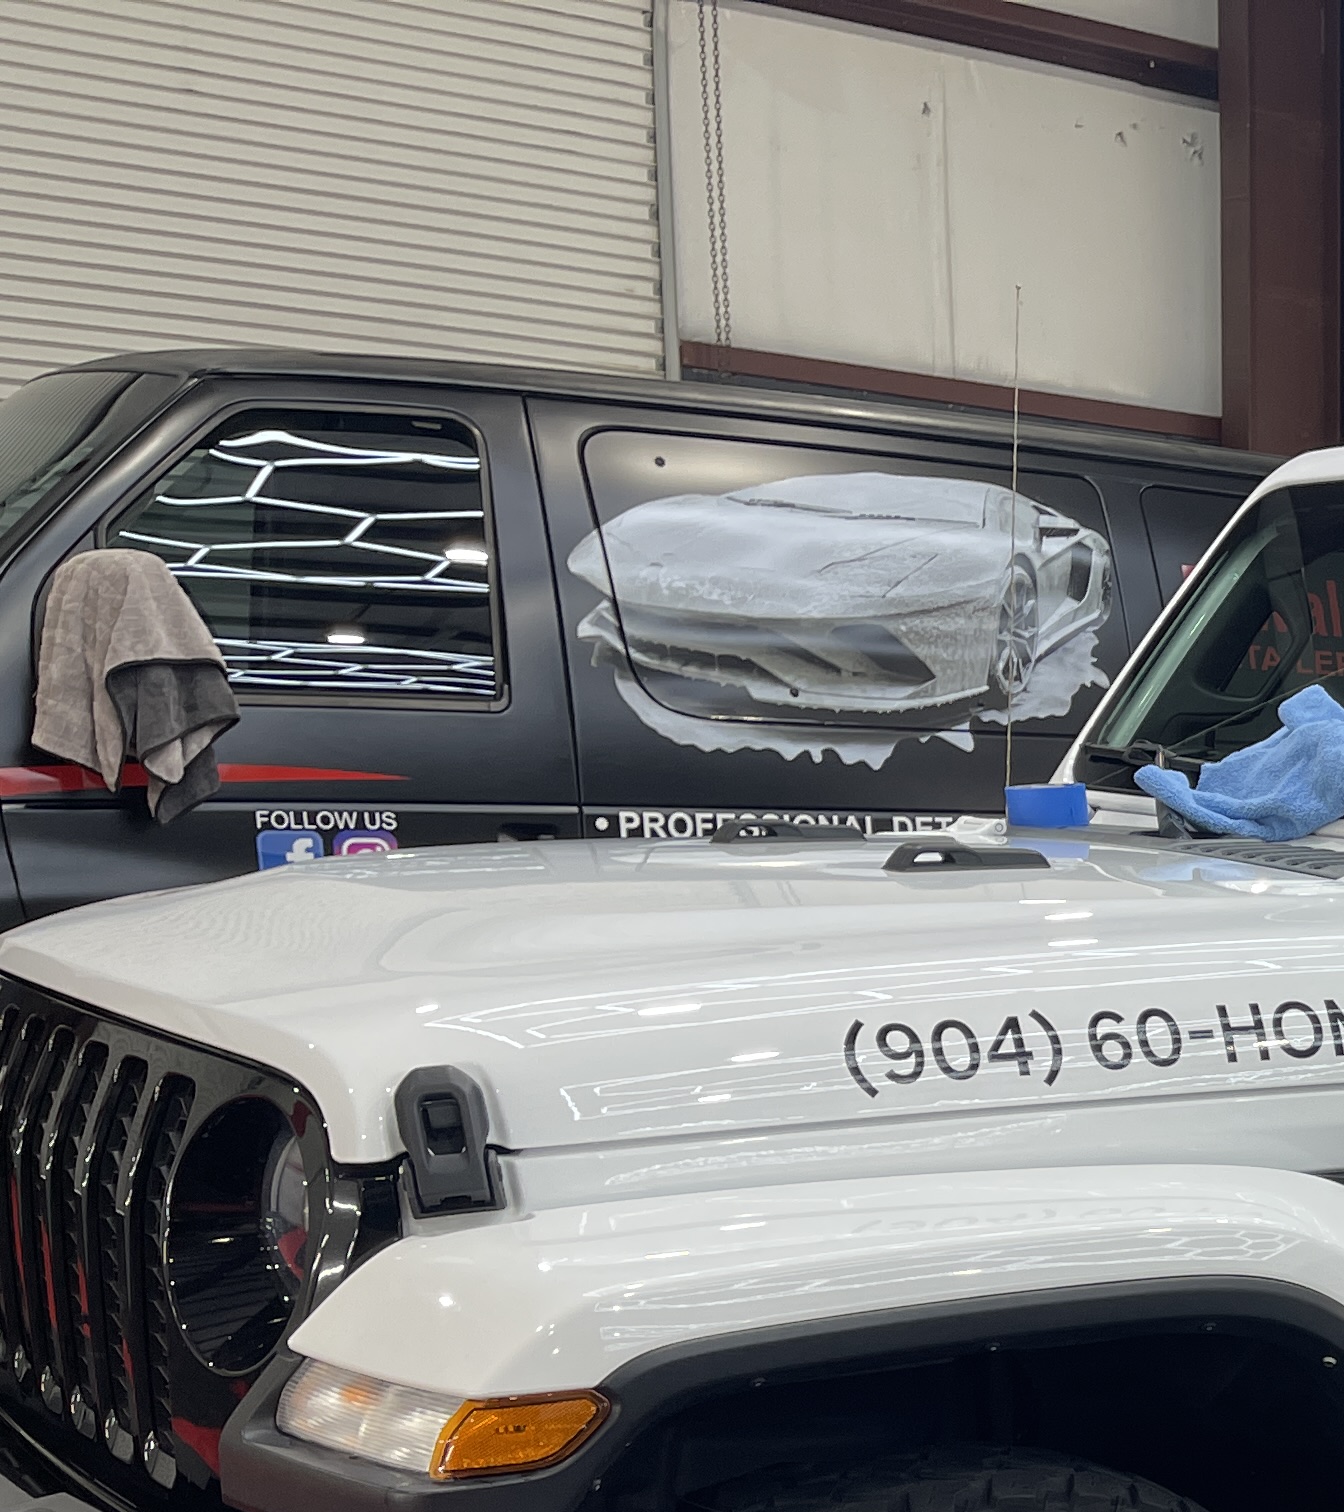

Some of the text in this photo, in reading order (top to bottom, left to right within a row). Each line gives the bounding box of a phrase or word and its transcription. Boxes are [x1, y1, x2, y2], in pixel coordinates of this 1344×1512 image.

[255, 810, 398, 831] FOLLOW US
[843, 1009, 1063, 1099] (904)
